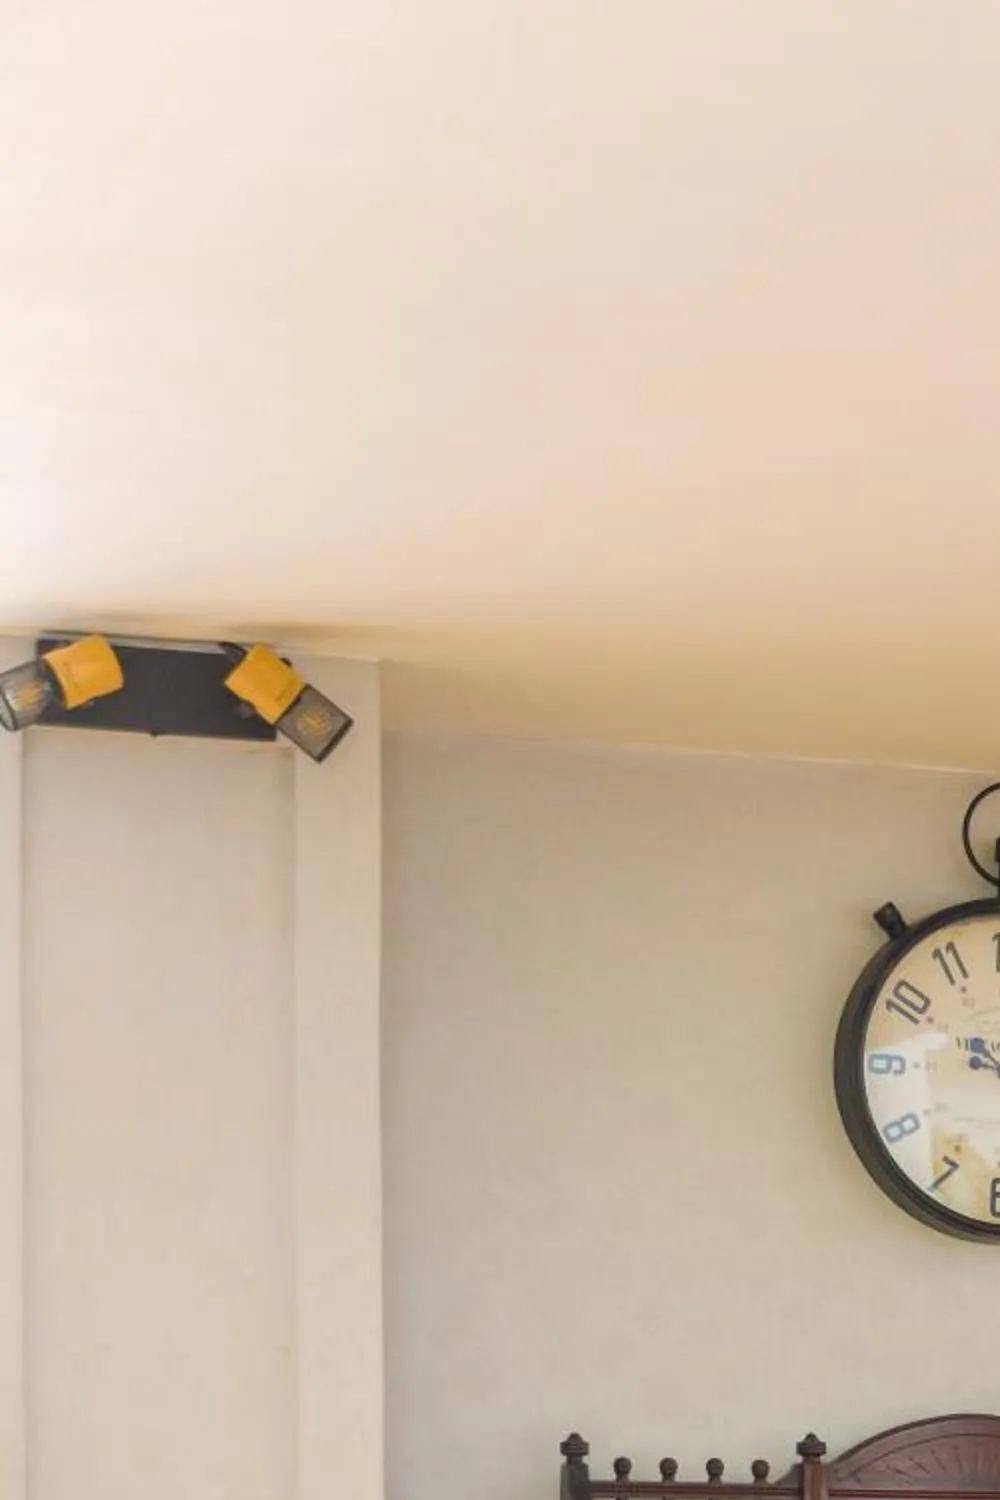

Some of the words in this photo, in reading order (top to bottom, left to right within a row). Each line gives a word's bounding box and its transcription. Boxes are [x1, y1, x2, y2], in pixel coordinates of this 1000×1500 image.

[933, 942, 968, 985] 11
[886, 980, 929, 1023] 10
[869, 1054, 905, 1075] 9
[883, 1113, 919, 1143] 8
[928, 1156, 959, 1191] 7
